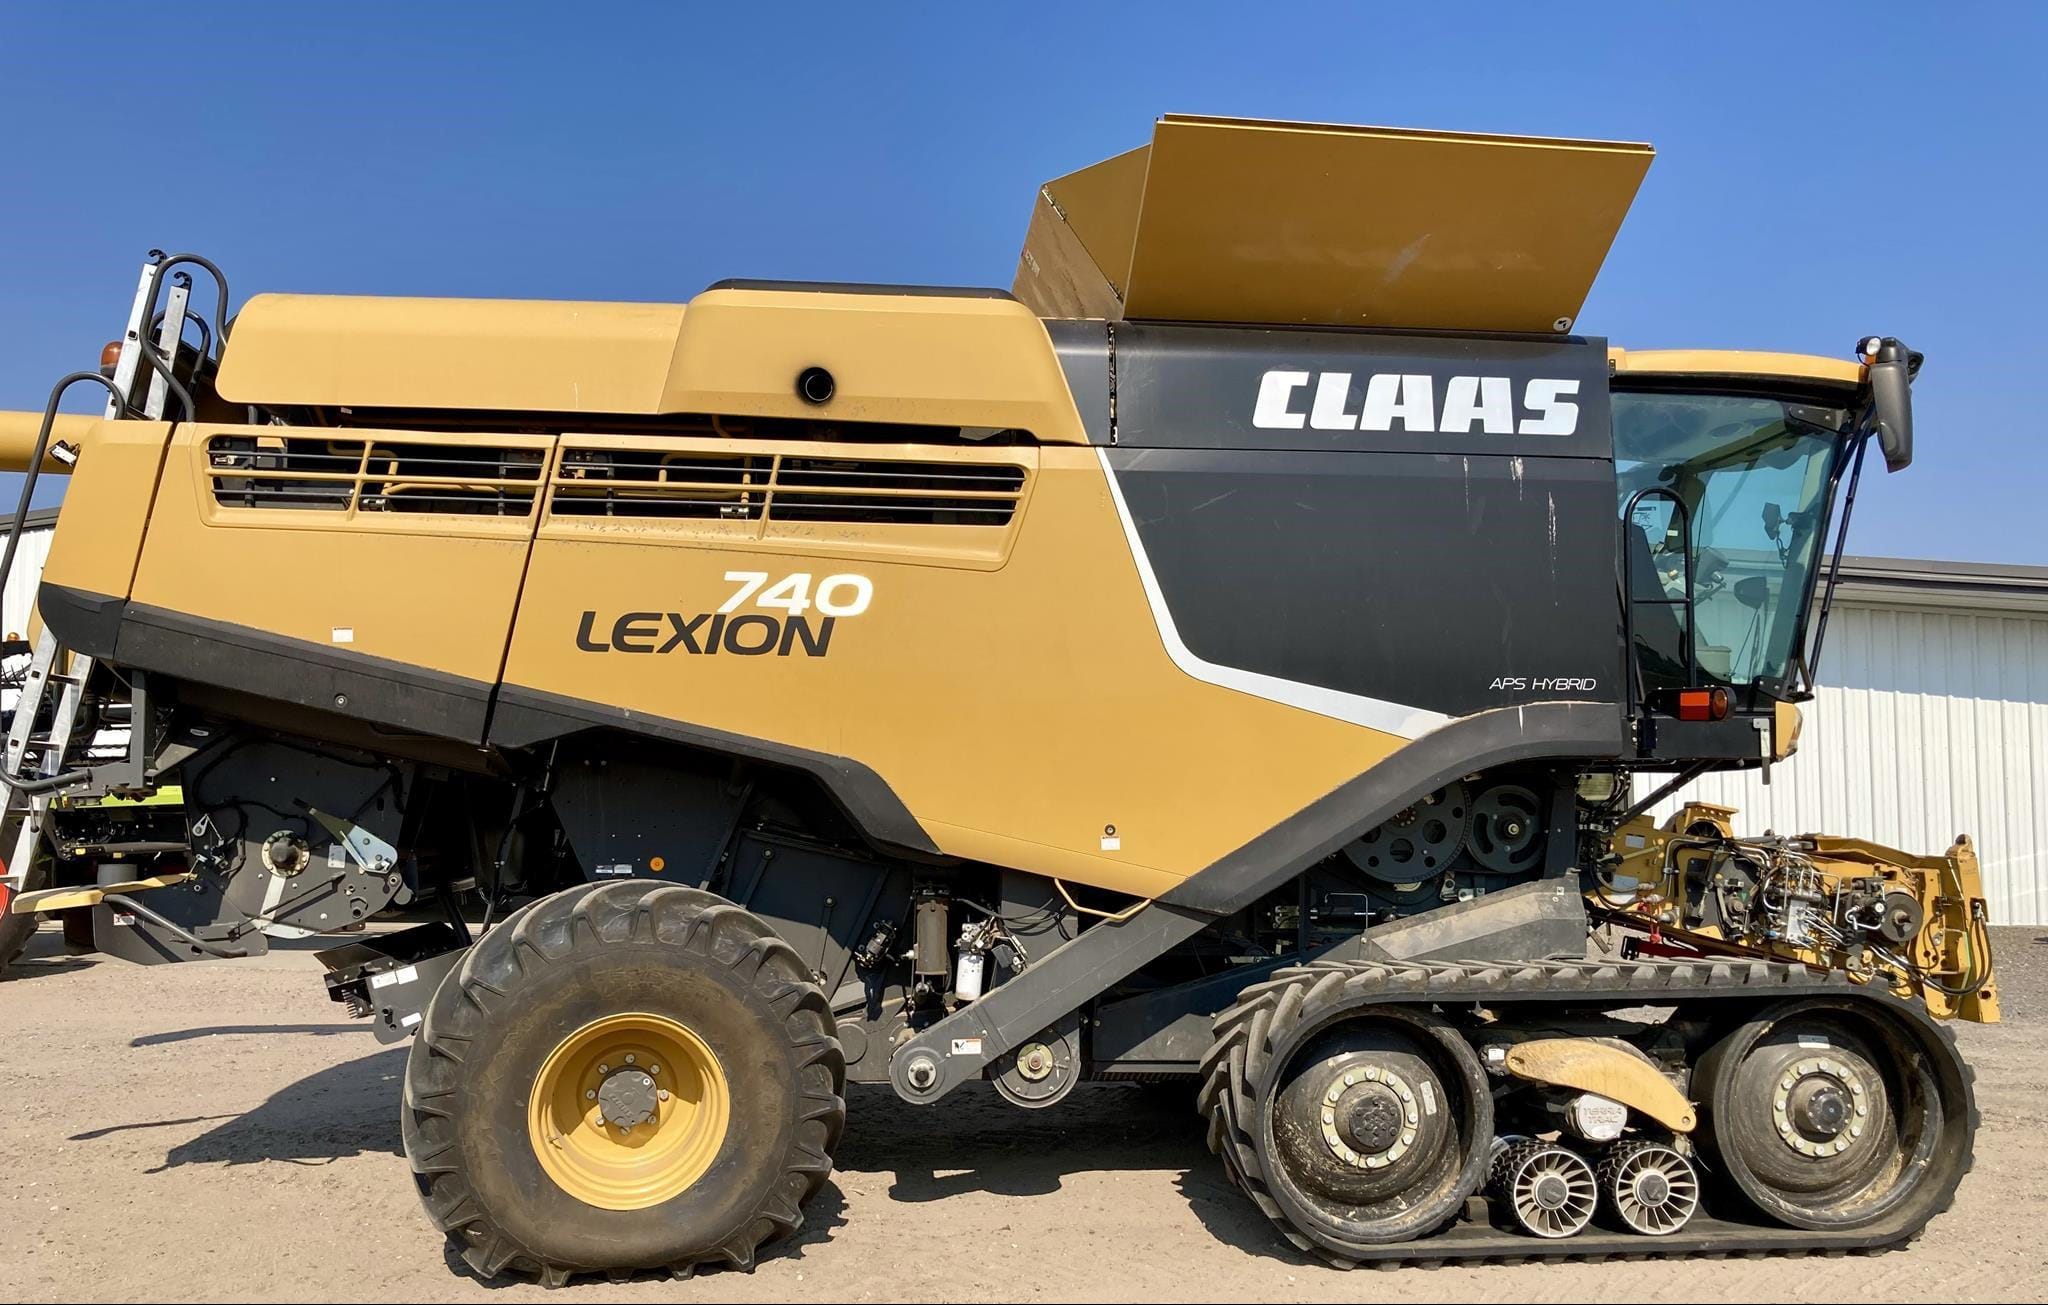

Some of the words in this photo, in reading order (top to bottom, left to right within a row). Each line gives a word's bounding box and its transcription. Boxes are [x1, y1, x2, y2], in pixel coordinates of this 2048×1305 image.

[1252, 370, 1581, 436] CLAAS
[717, 570, 874, 617] 740
[576, 610, 836, 657] LEXION
[1488, 677, 1527, 690] APS
[1531, 677, 1597, 691] HYBRID
